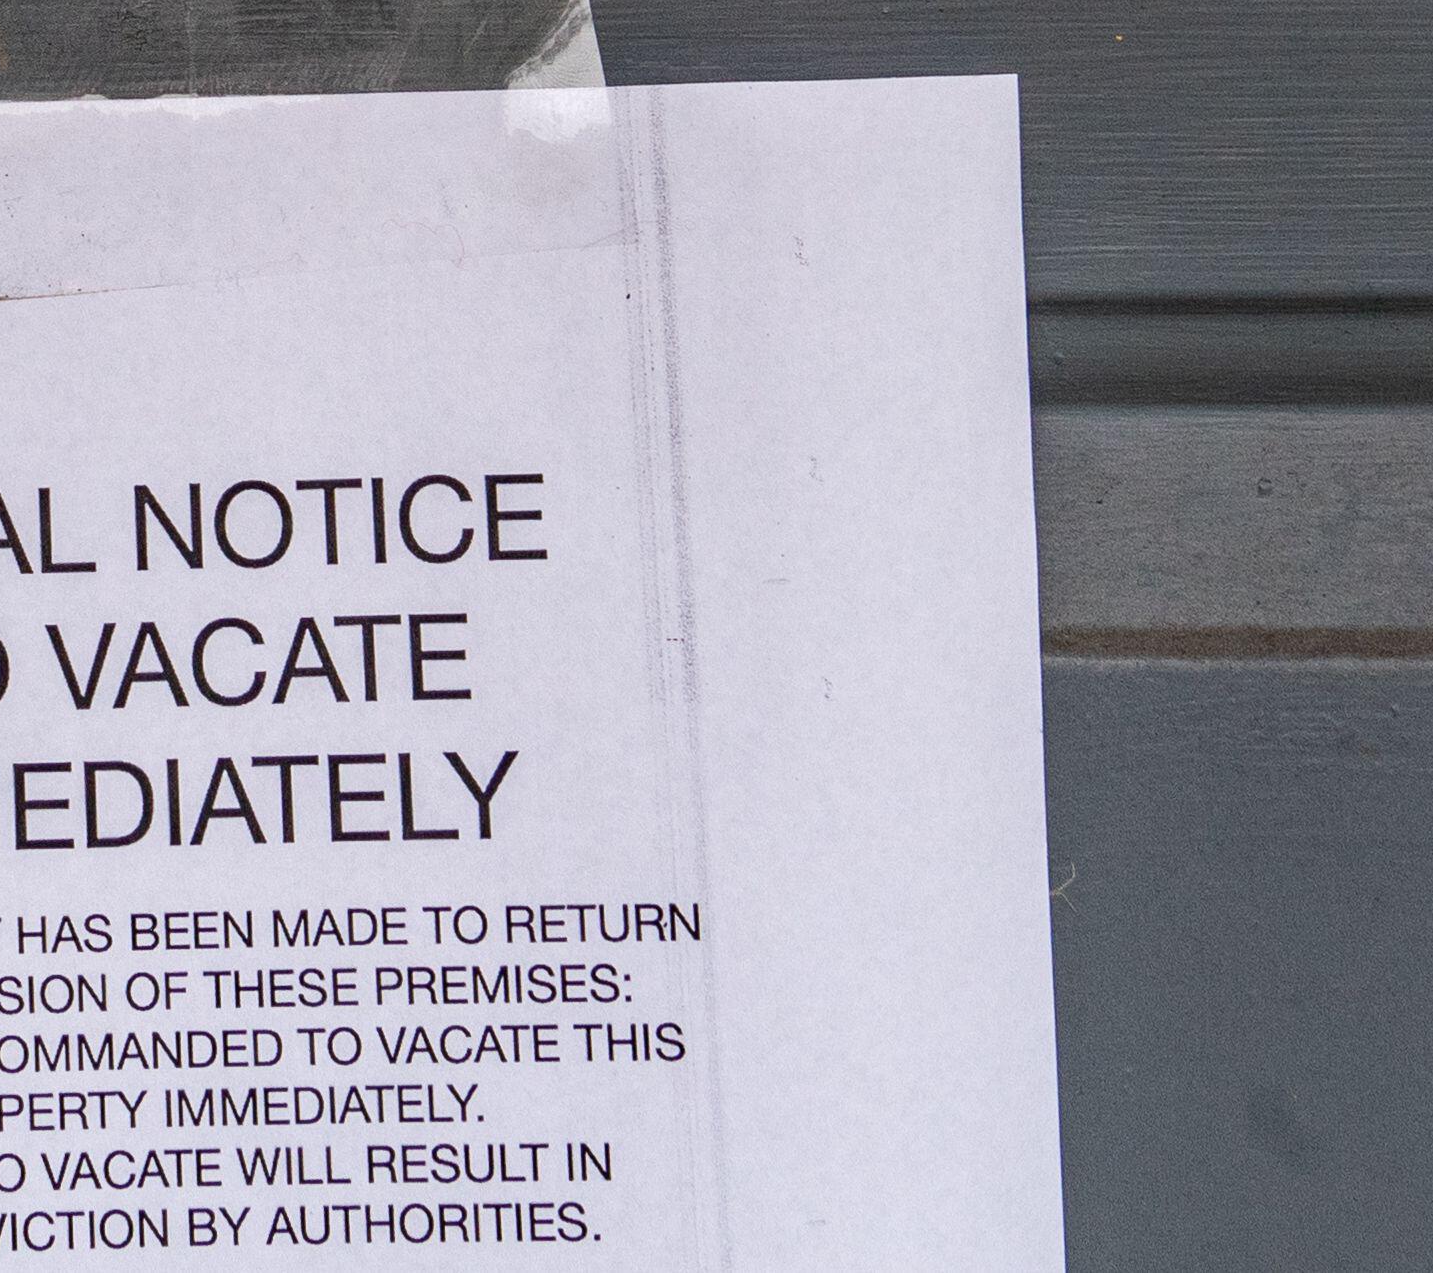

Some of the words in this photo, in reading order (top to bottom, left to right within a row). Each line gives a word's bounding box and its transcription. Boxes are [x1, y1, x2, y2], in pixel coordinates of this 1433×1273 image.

[133, 473, 548, 572] NOTICE
[44, 612, 472, 711] VACATE
[17, 913, 113, 955] HAS
[130, 910, 254, 952] BEEN
[272, 906, 409, 948] MADE
[422, 905, 488, 945] TO
[505, 902, 701, 944] RETURN
[125, 971, 189, 1012] OF
[202, 967, 359, 1009] THESE
[375, 963, 632, 1006] PREMISES:
[296, 1026, 363, 1066] TO
[375, 1023, 561, 1065] VACATE
[572, 1022, 686, 1063] THIS
[165, 1083, 485, 1128] IMMEDIATELY.
[40, 1148, 223, 1191] VACATE
[235, 1145, 352, 1186] WILL
[366, 1143, 550, 1184] RESULT
[566, 1142, 612, 1182] IN
[187, 1206, 251, 1247] BY
[266, 1201, 601, 1246] AUTHORITIES.
